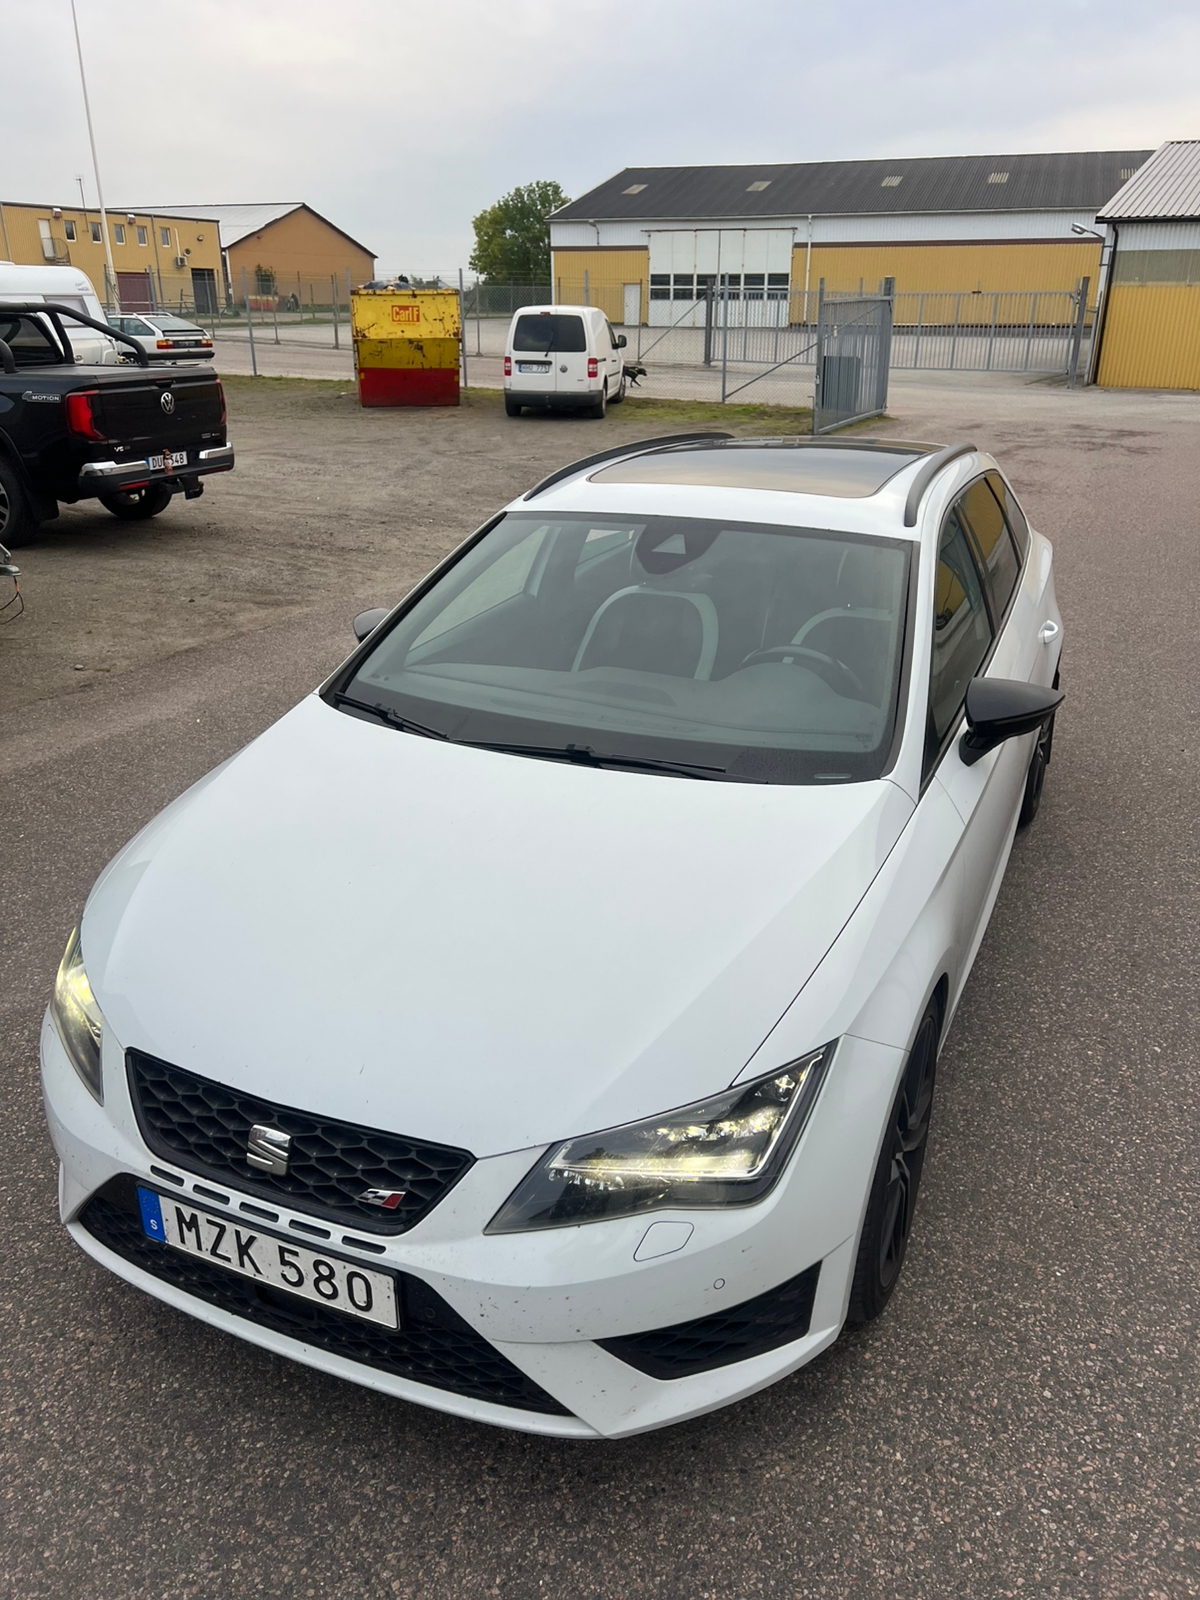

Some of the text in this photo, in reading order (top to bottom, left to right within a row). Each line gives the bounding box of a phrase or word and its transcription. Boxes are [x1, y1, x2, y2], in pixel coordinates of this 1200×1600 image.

[150, 1219, 158, 1231] S
[174, 1205, 374, 1313] MZK 580
